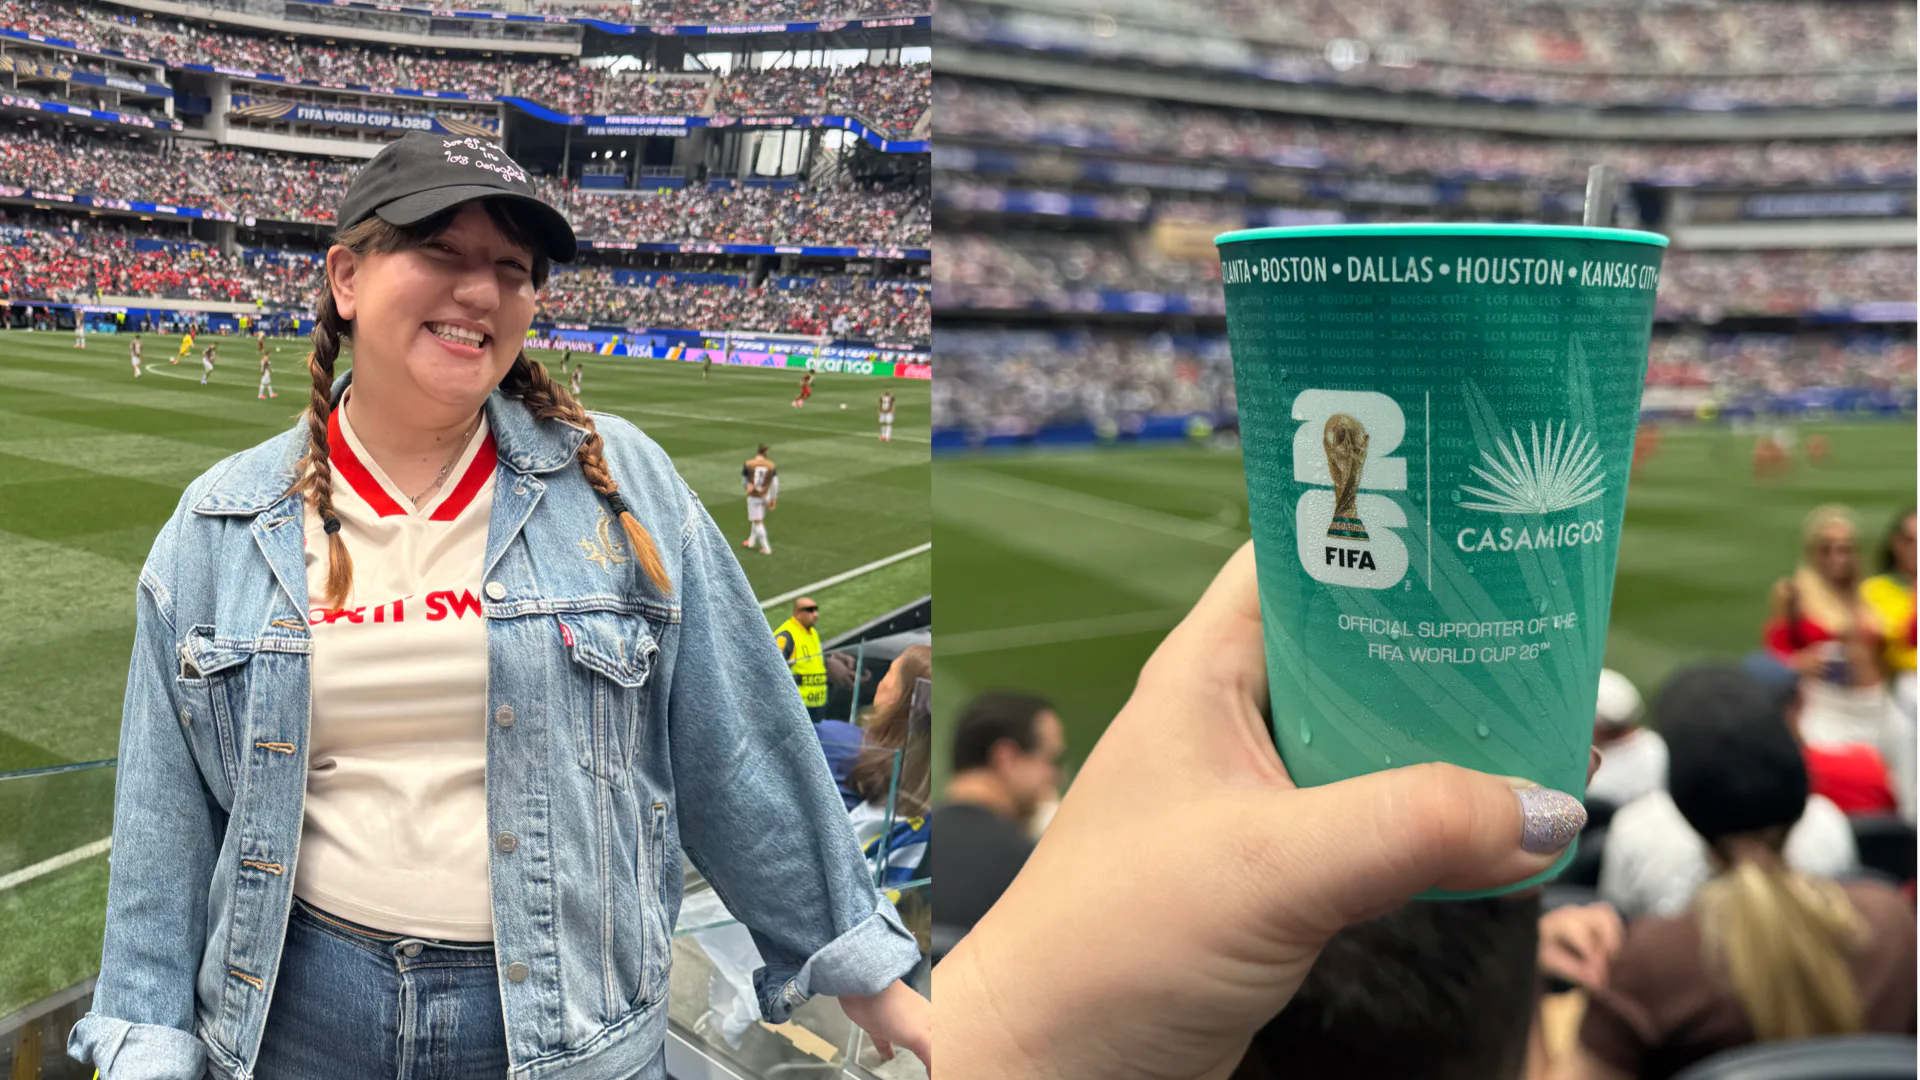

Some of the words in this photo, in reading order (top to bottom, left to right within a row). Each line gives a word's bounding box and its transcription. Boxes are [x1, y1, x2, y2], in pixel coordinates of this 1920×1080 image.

[298, 107, 323, 120] FIFA
[324, 109, 366, 124] WORLD
[367, 113, 391, 126] CUP
[391, 116, 432, 130] 2026
[606, 115, 620, 124] FIFA
[621, 115, 645, 125] WORLD
[646, 116, 660, 125] CUP
[587, 126, 606, 135] FIFA
[607, 126, 637, 136] WORLD
[638, 127, 656, 136] CUP
[1261, 256, 1327, 283] BOSTON
[1347, 256, 1434, 283] DALLAS
[1456, 257, 1564, 285] HOUSTON
[1581, 260, 1636, 289] KANSAS
[1638, 264, 1656, 290] CITY
[1318, 295, 1373, 306] HOUSTON
[1390, 295, 1437, 306] KANSAS
[1442, 295, 1468, 305] CITY
[1486, 295, 1508, 305] LOS
[1512, 295, 1561, 306] ANGELES
[1319, 312, 1374, 323] HOUSTON
[1390, 313, 1438, 323] KANSAS
[1442, 313, 1468, 324] CITY
[1485, 313, 1507, 323] LOS
[1512, 313, 1559, 324] ANGELES
[1320, 329, 1374, 340] HOUSTON
[1442, 331, 1468, 341] CITY
[1485, 331, 1505, 341] LOS
[1511, 331, 1558, 341] ANGELES
[553, 340, 594, 353] AIRWAYS
[625, 343, 653, 358] VISA
[1321, 347, 1374, 358] HOUSTON
[806, 357, 874, 374] aramco
[1457, 519, 1604, 552] CASAMIGOS
[1325, 546, 1376, 570] FIFA
[1338, 614, 1414, 637] OFFICIAL
[1418, 619, 1524, 639] SUPPORTER
[1528, 617, 1548, 634] OF
[1552, 612, 1577, 630] THE
[1368, 643, 1404, 661] FIFA
[1409, 645, 1476, 664] WORLD
[1480, 645, 1516, 663] CUP
